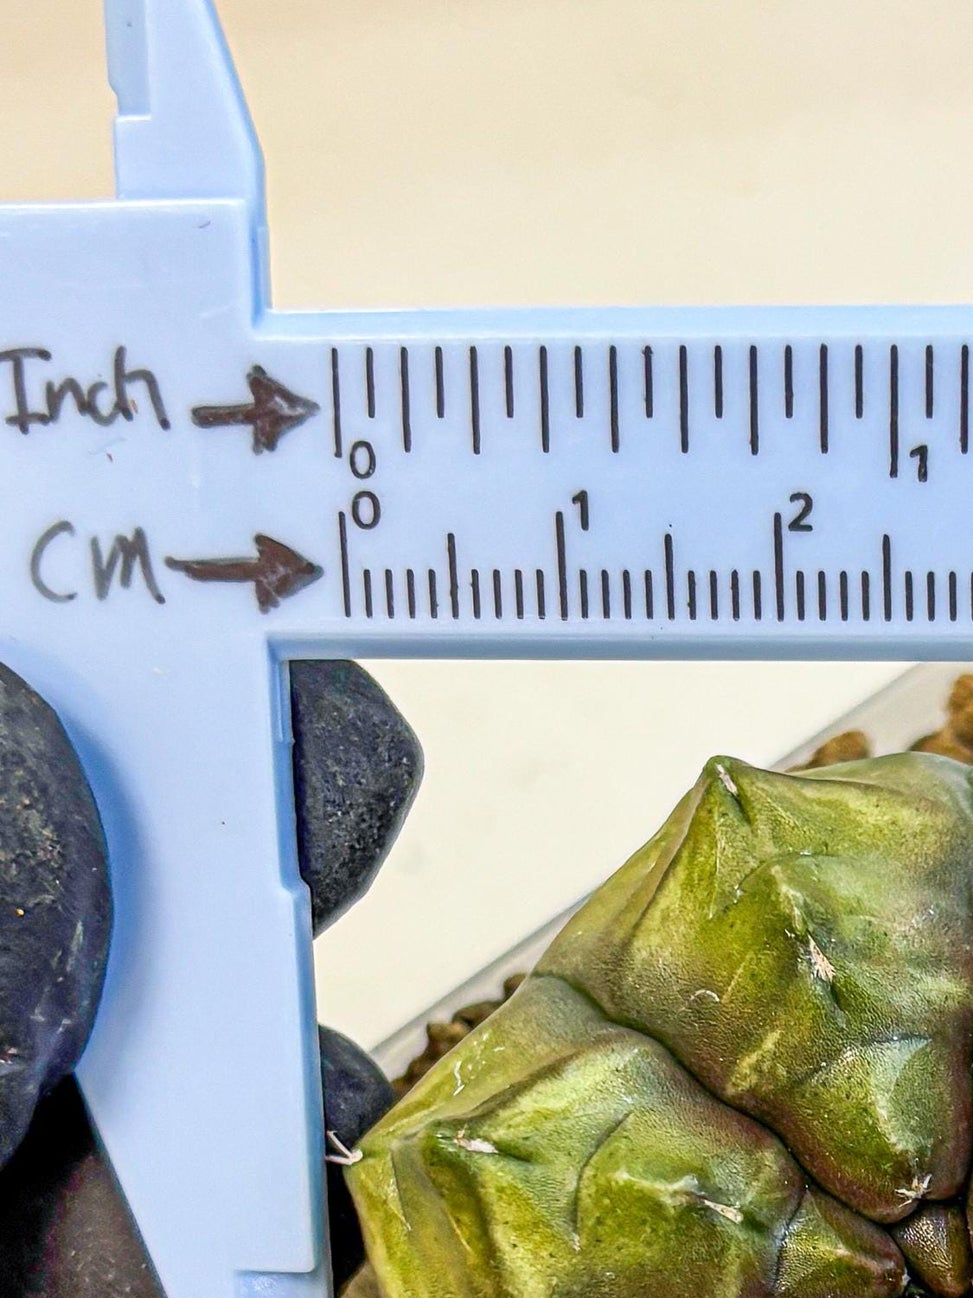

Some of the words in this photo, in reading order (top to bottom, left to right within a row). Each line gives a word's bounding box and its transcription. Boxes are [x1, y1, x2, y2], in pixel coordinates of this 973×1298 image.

[0, 345, 171, 435] Inch
[349, 440, 377, 480] 0
[909, 444, 929, 483] 1
[351, 490, 381, 530] 0
[571, 489, 590, 532] 1
[787, 491, 814, 533] 2
